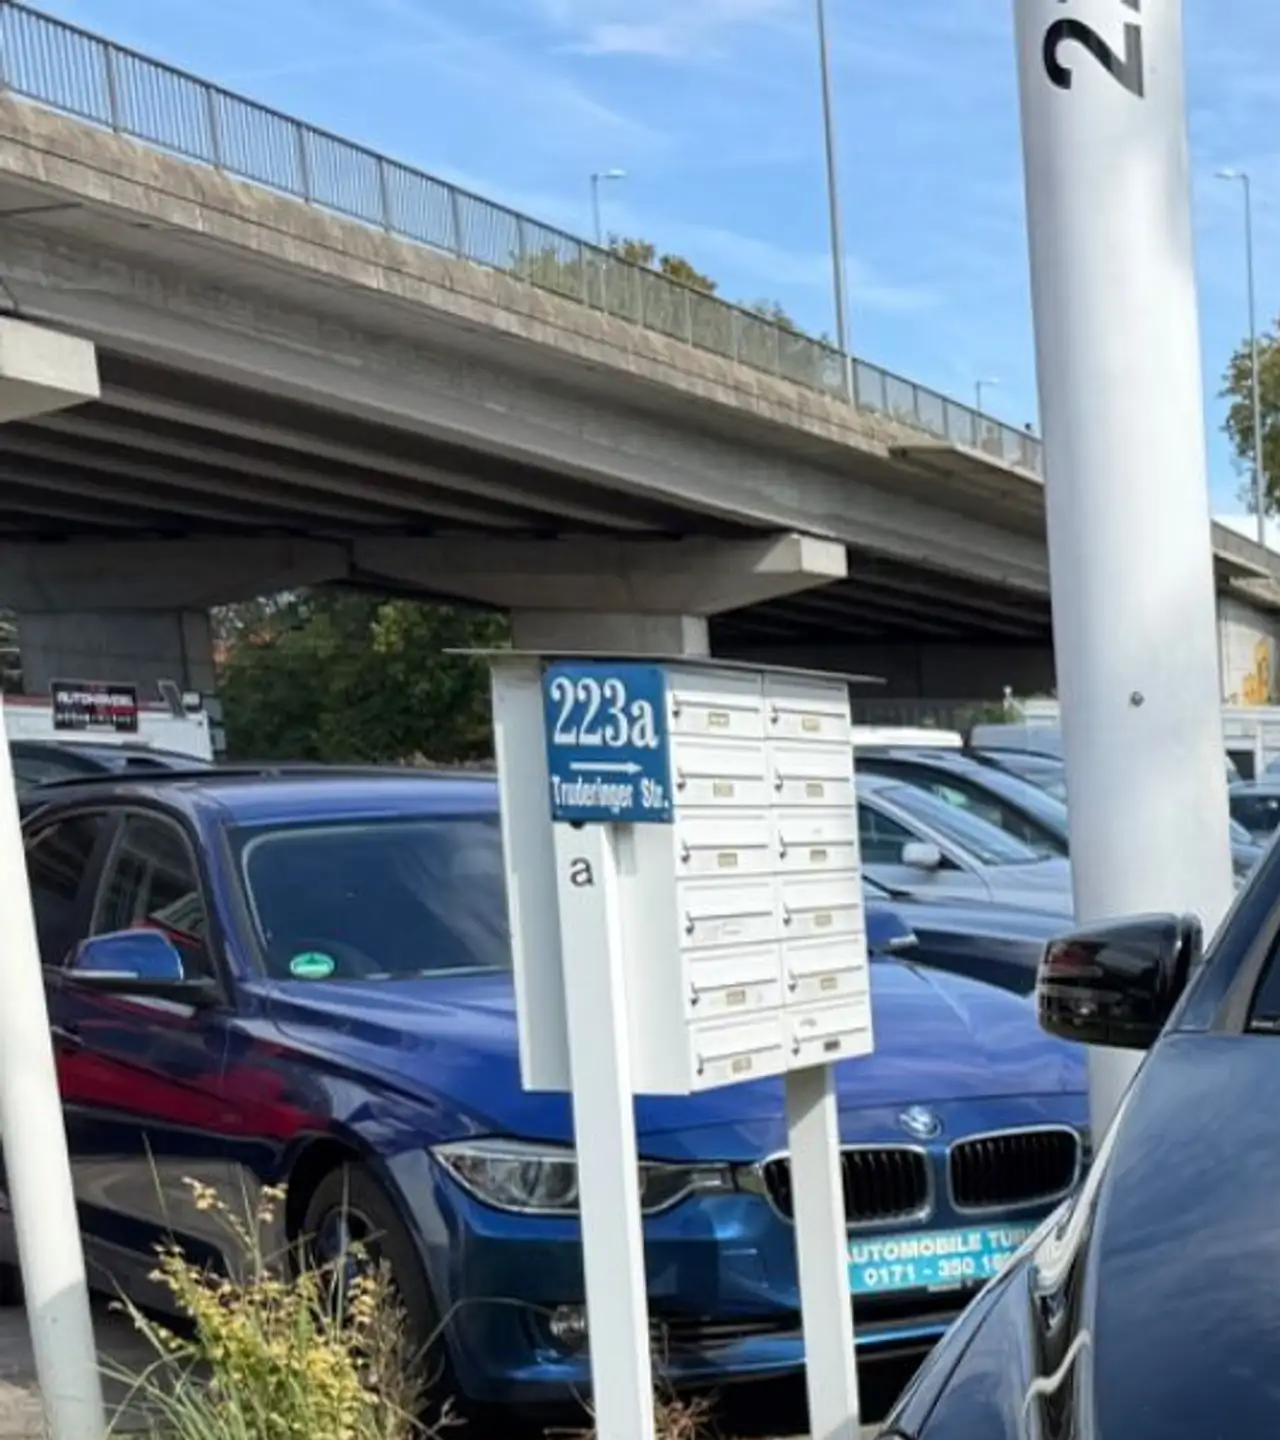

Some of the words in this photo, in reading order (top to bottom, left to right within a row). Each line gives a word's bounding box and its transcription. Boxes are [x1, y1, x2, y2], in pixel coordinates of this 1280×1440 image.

[550, 676, 659, 748] 223a
[551, 775, 634, 814] Truderinger
[640, 779, 669, 809] Str.
[569, 857, 594, 887] a
[848, 1232, 982, 1263] UTOMOBILE
[864, 1263, 915, 1286] 0171
